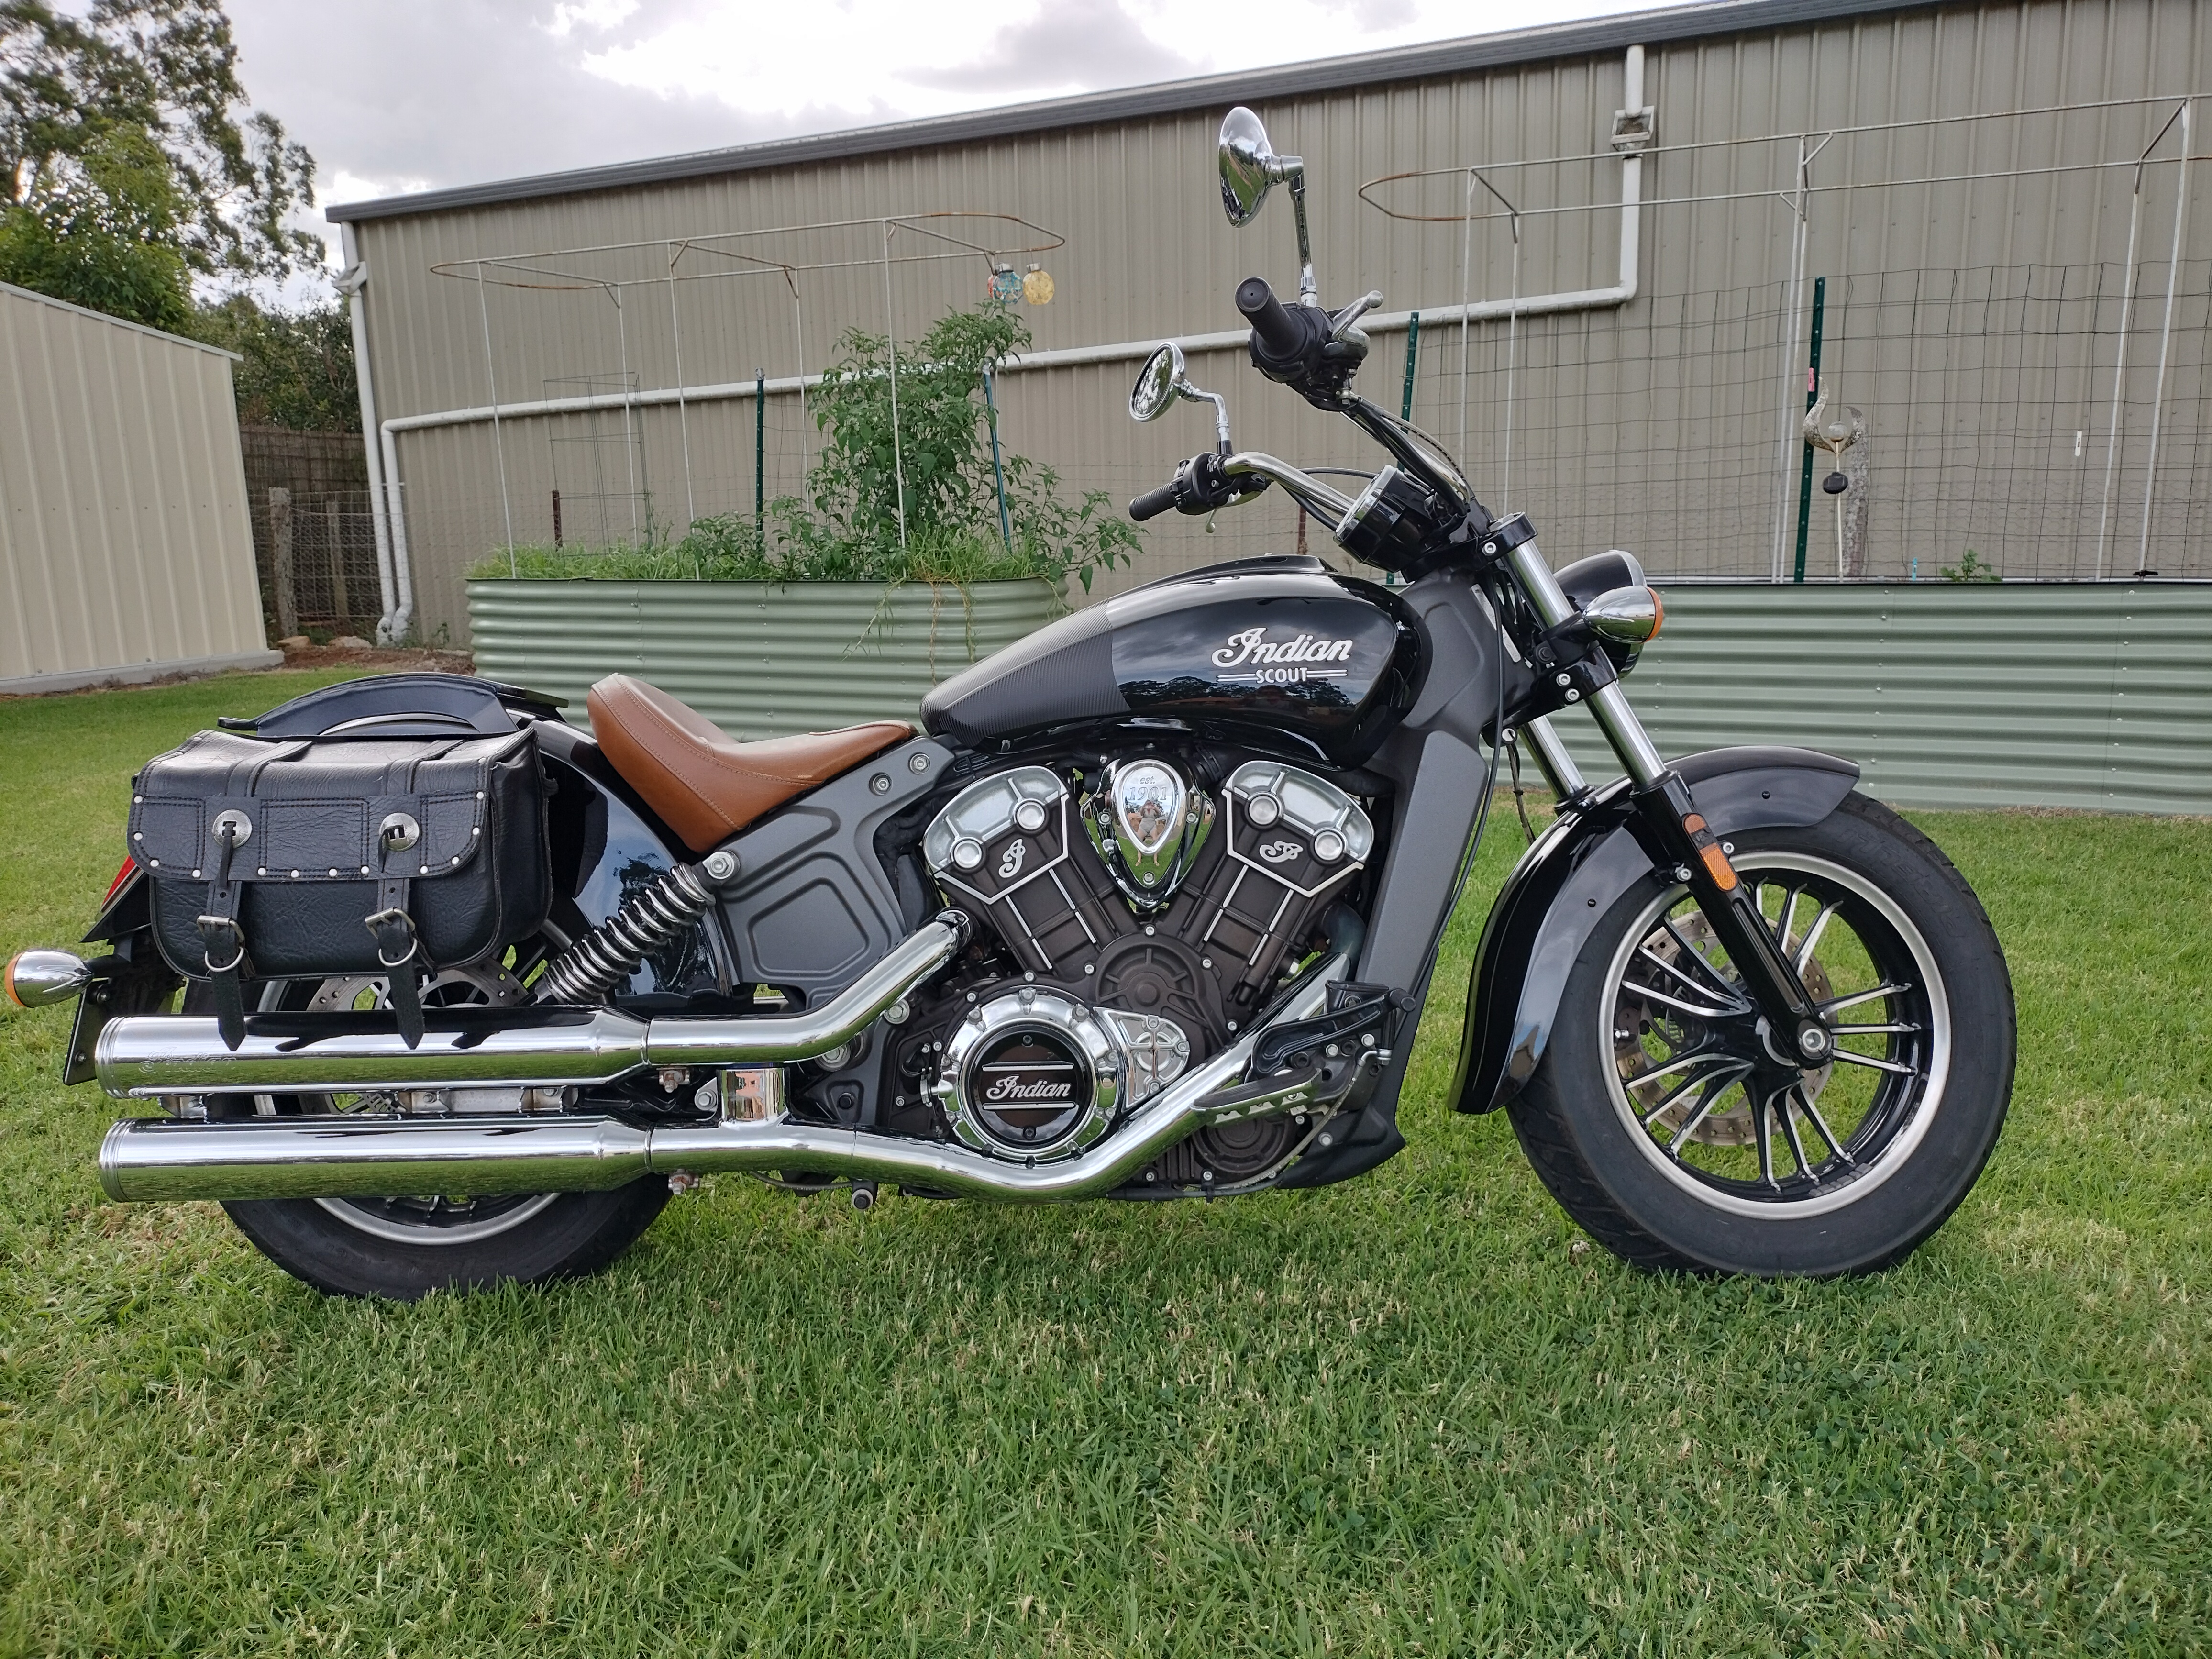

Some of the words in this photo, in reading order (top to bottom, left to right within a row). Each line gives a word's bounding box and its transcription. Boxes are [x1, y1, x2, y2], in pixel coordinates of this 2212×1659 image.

[1211, 627, 1353, 667] Indian
[1256, 667, 1308, 684] SCOUT
[1139, 776, 1155, 784] est.
[1128, 786, 1167, 801] 1901
[986, 1075, 1071, 1099] Indian
